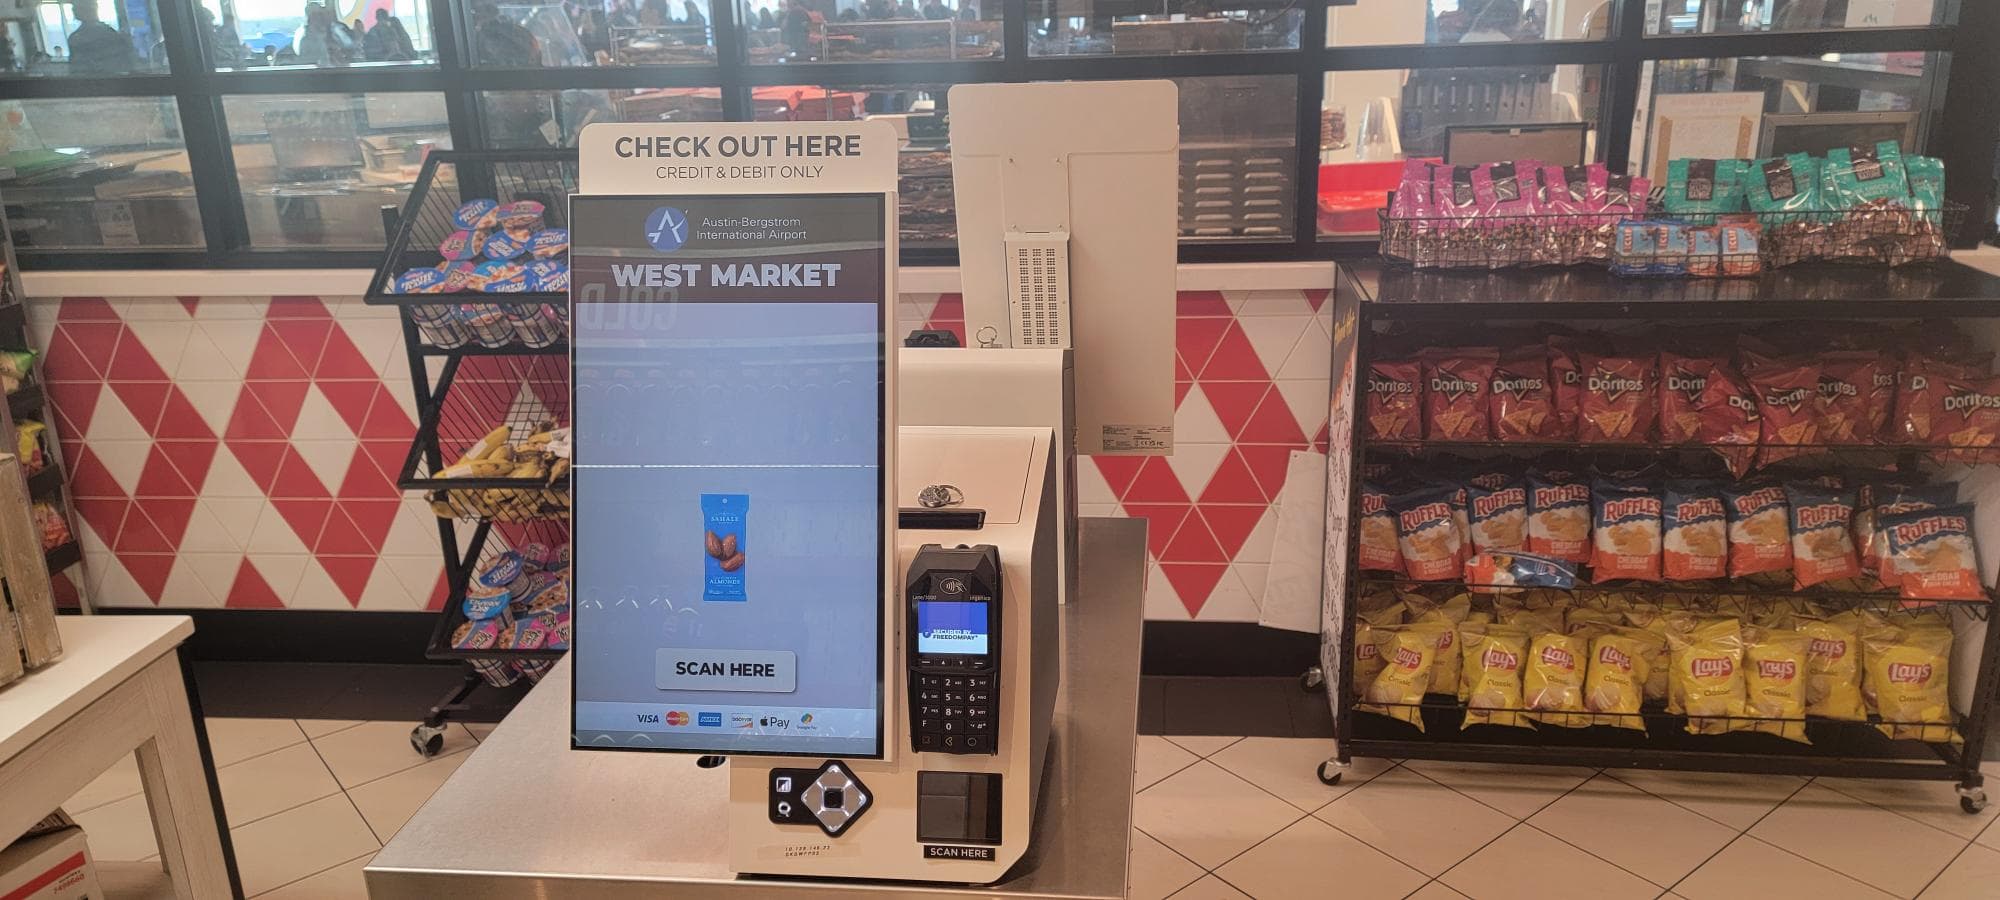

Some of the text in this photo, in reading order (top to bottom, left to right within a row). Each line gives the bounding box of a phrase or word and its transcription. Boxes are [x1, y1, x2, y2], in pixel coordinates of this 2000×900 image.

[615, 135, 861, 158] CHECK OUT HERE
[656, 165, 824, 179] CREDIT & DEBIT ONLY
[702, 217, 801, 230] Austin-Bergstrom
[696, 229, 807, 241] International Airport
[611, 263, 841, 287] WEST MARKET
[1368, 380, 1413, 392] Doritos
[1432, 378, 1479, 392] Doritos
[1493, 378, 1542, 394] Doritos
[1588, 377, 1644, 391] Doritos
[1817, 382, 1857, 396] oritos
[1535, 484, 1589, 508] RUFFLES
[1603, 497, 1661, 522] RUFFLES
[1897, 516, 1967, 545] RUFFLES
[676, 661, 775, 677] SCAN HERE
[969, 679, 975, 687] 3
[637, 714, 659, 723] VISA
[770, 717, 790, 729] Pay
[930, 848, 988, 857] SCAN HERE
